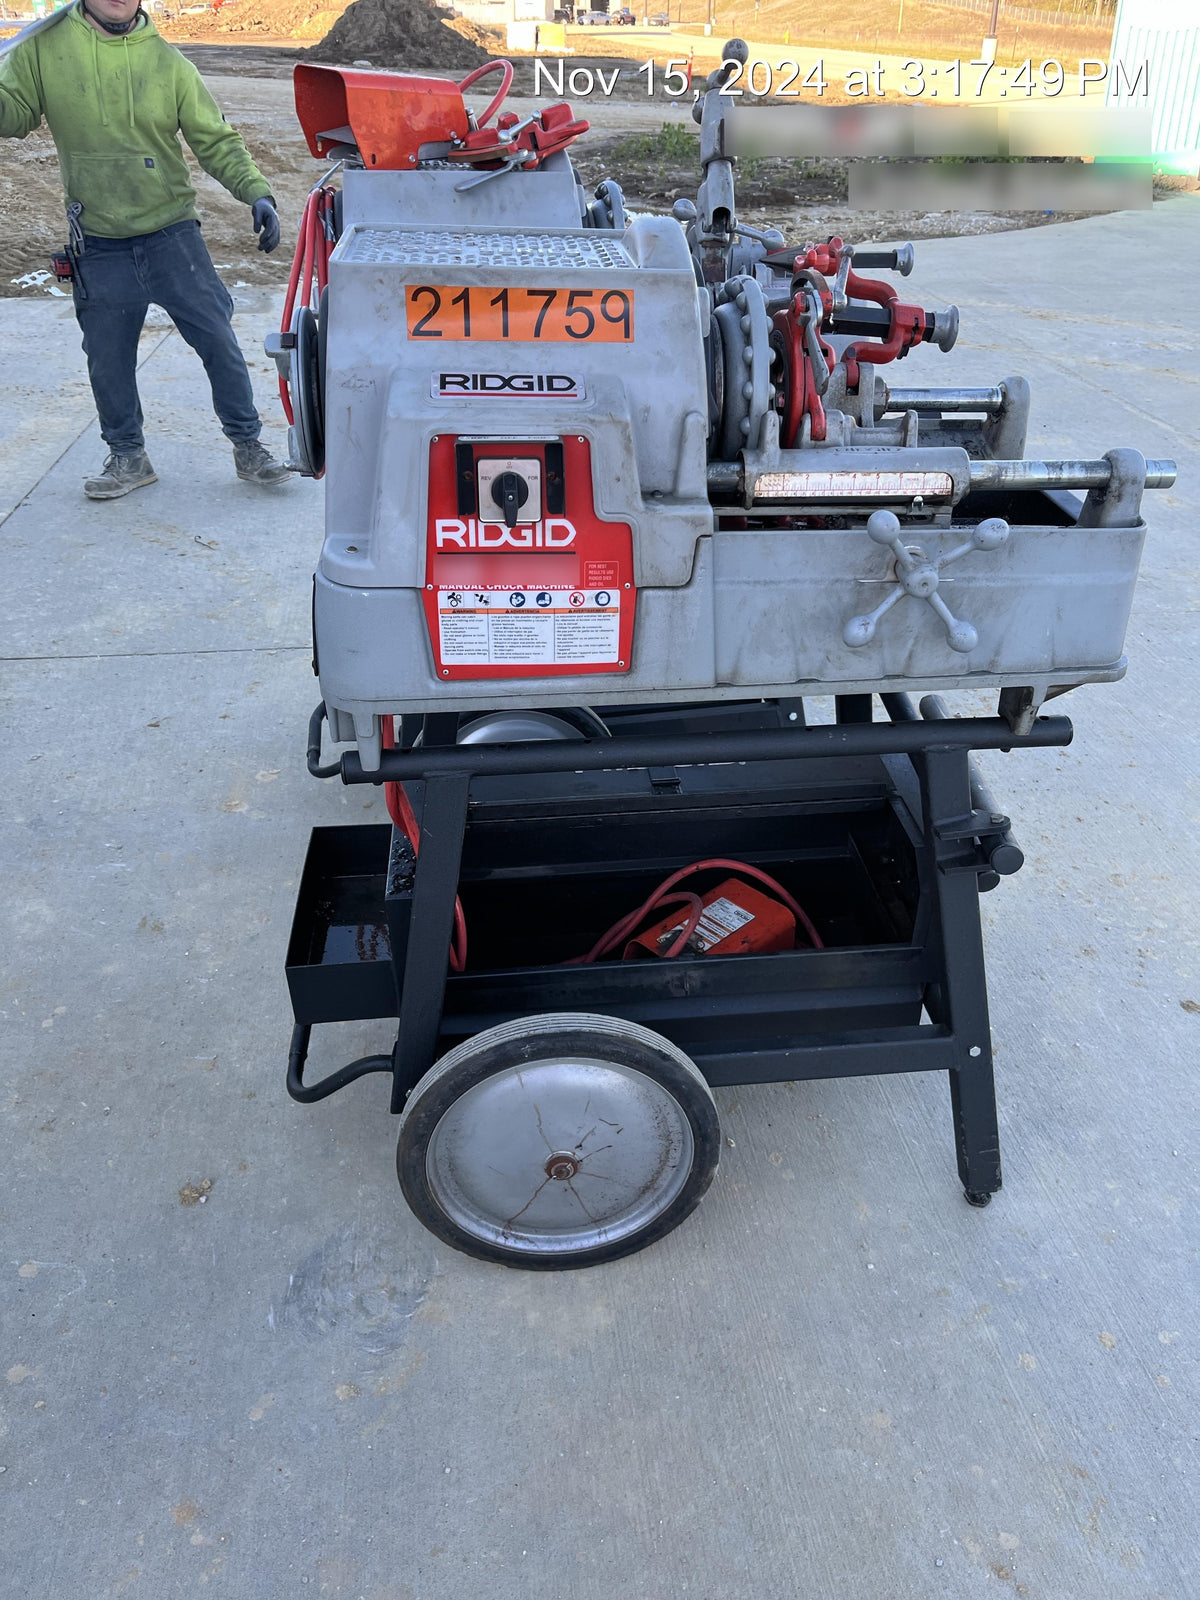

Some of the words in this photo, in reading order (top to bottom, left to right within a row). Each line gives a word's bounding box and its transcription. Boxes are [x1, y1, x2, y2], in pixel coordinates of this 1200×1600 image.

[411, 286, 631, 339] 211759
[439, 373, 577, 392] RIDGID
[435, 519, 577, 548] RIDGID
